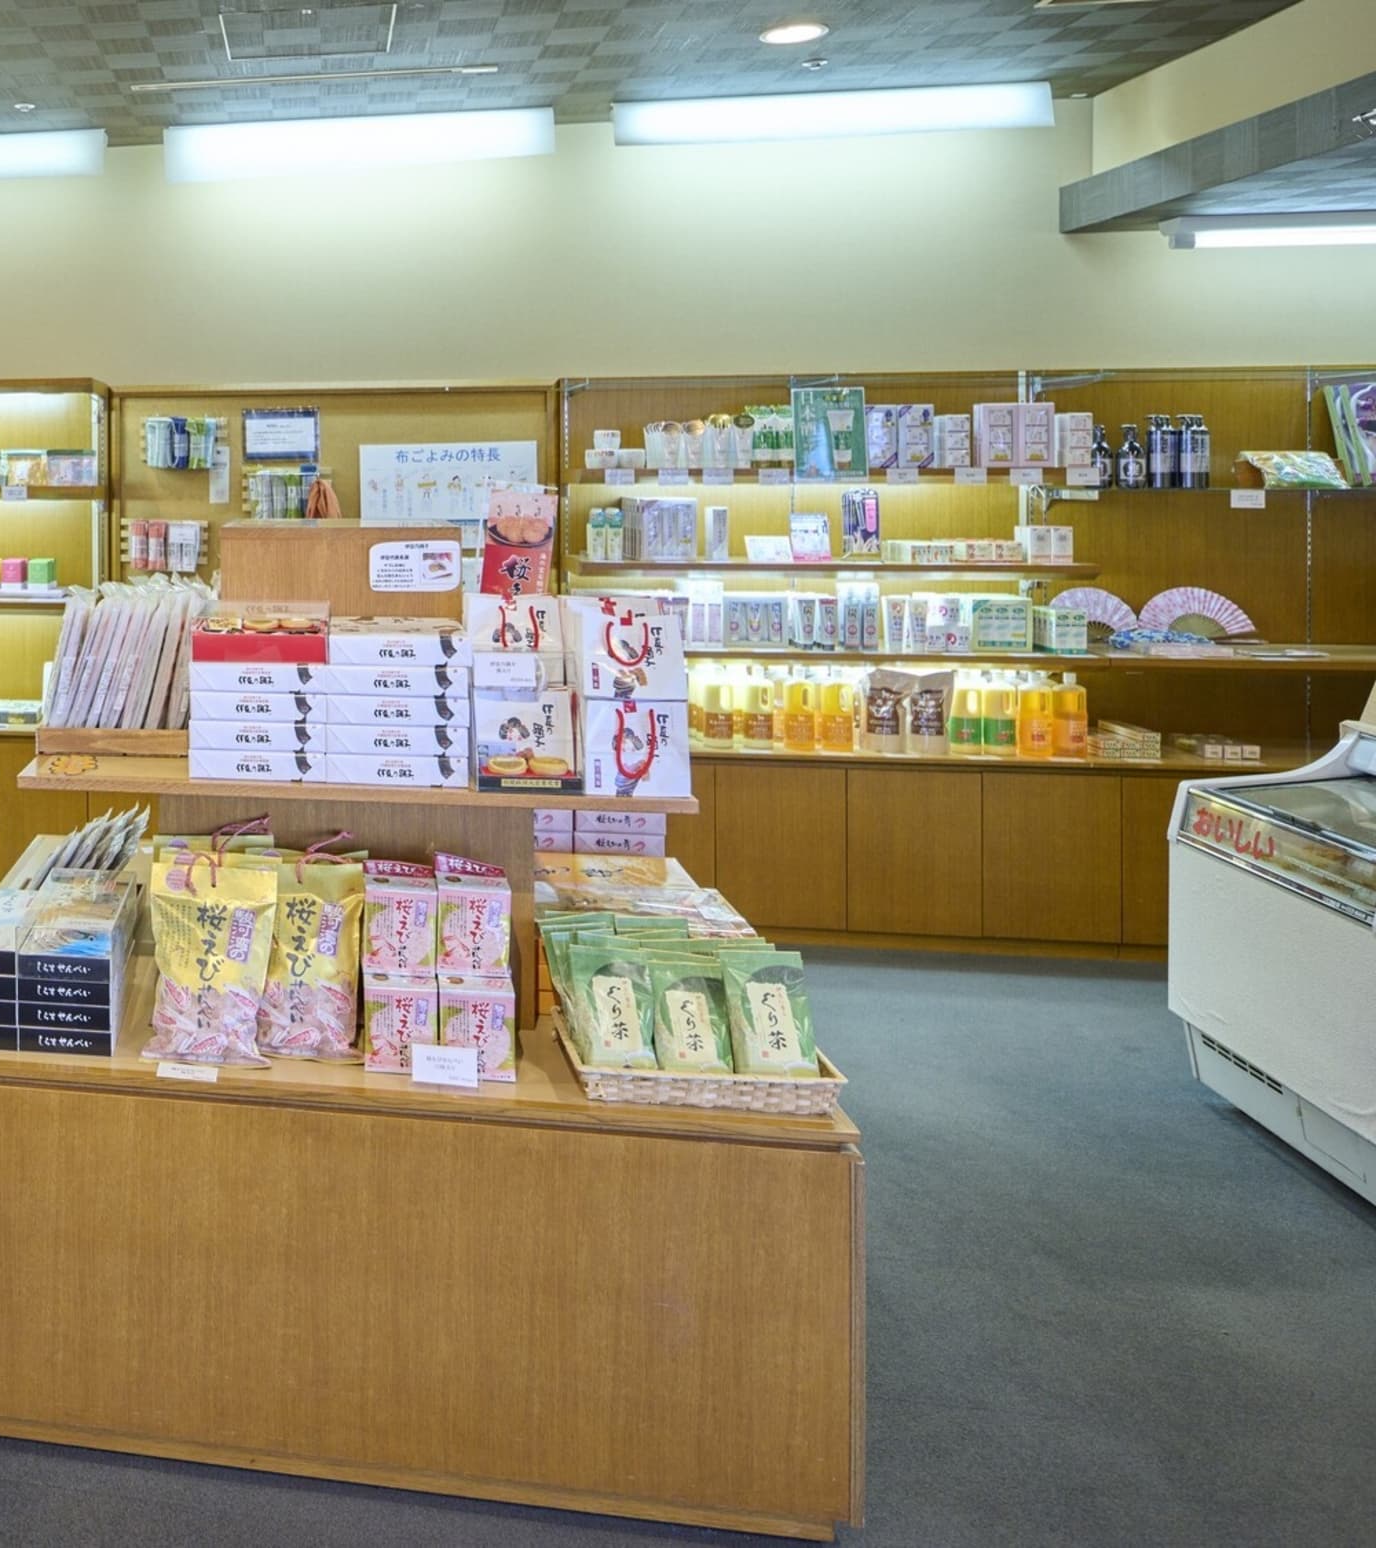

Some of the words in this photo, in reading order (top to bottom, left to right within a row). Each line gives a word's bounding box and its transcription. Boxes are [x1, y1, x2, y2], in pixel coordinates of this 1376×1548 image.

[395, 448, 501, 464] 布ごよみの特長
[1192, 806, 1277, 860] おいしい
[37, 961, 92, 975] しらすせんべい
[196, 902, 228, 1029] 桜えびせんべい
[285, 896, 317, 1024] 桜えびせんべい
[36, 984, 91, 998] しらすせんべい
[37, 1009, 92, 1023] しらすせんべい
[606, 985, 630, 1041] ぐり茶
[38, 1034, 93, 1049] しらすせんべい
[680, 999, 704, 1052] ぐり茶
[761, 992, 787, 1050] ぐり茶
